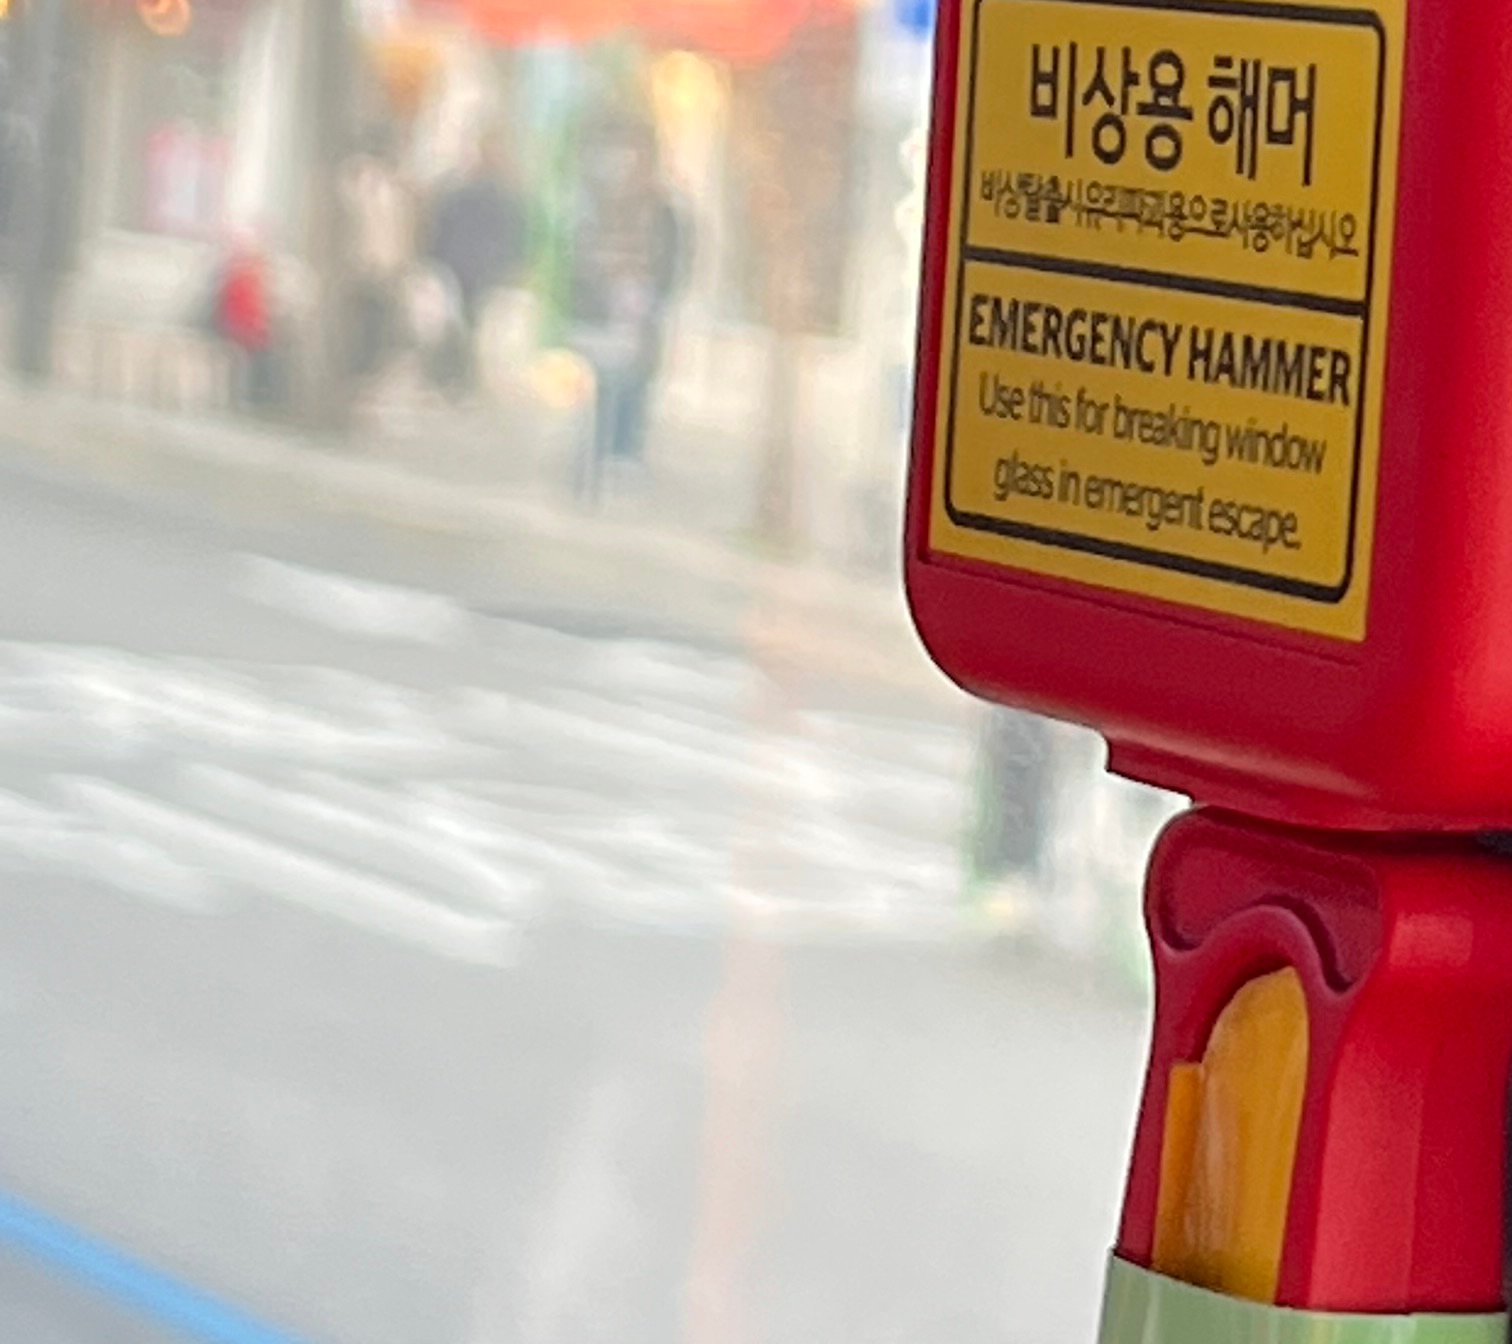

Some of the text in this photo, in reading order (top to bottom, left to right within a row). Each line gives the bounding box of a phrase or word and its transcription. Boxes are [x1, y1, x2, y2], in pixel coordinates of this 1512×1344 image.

[1029, 41, 1317, 186] 비상용 해머
[969, 294, 1351, 406] EMERGENCY HAMMER
[978, 371, 1327, 474] Use this for breaking window
[993, 450, 1302, 553] glass in emergent escape.
